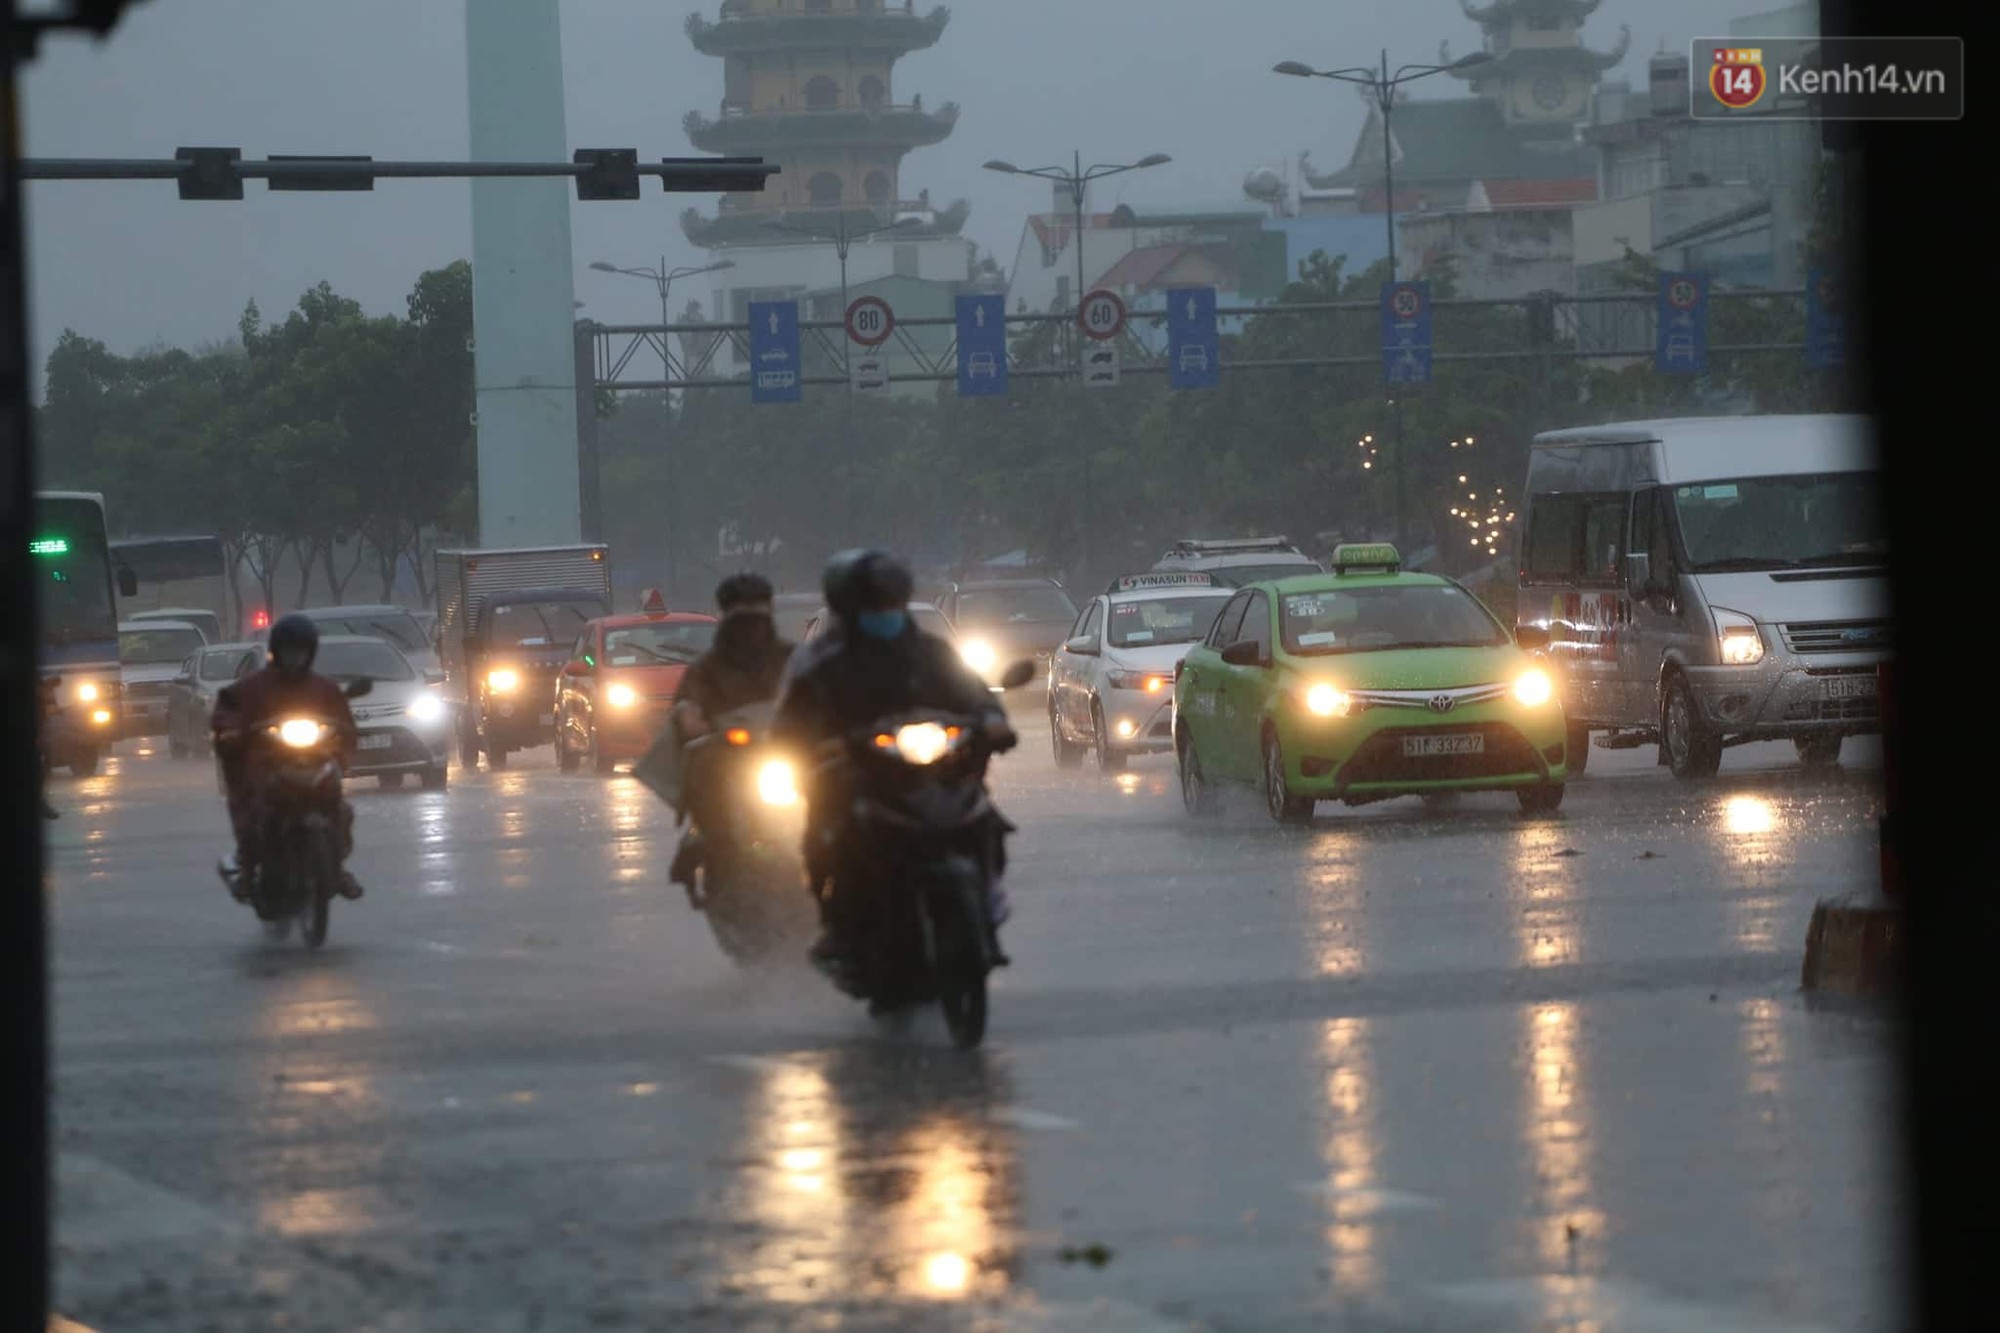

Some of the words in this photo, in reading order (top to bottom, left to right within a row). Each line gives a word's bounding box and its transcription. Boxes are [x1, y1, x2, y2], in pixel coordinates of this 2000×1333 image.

[1398, 294, 1414, 312] 50
[859, 310, 879, 330] 80
[1091, 304, 1111, 325] 60
[1140, 574, 1186, 585] VINASUN
[1189, 573, 1209, 583] TAXI
